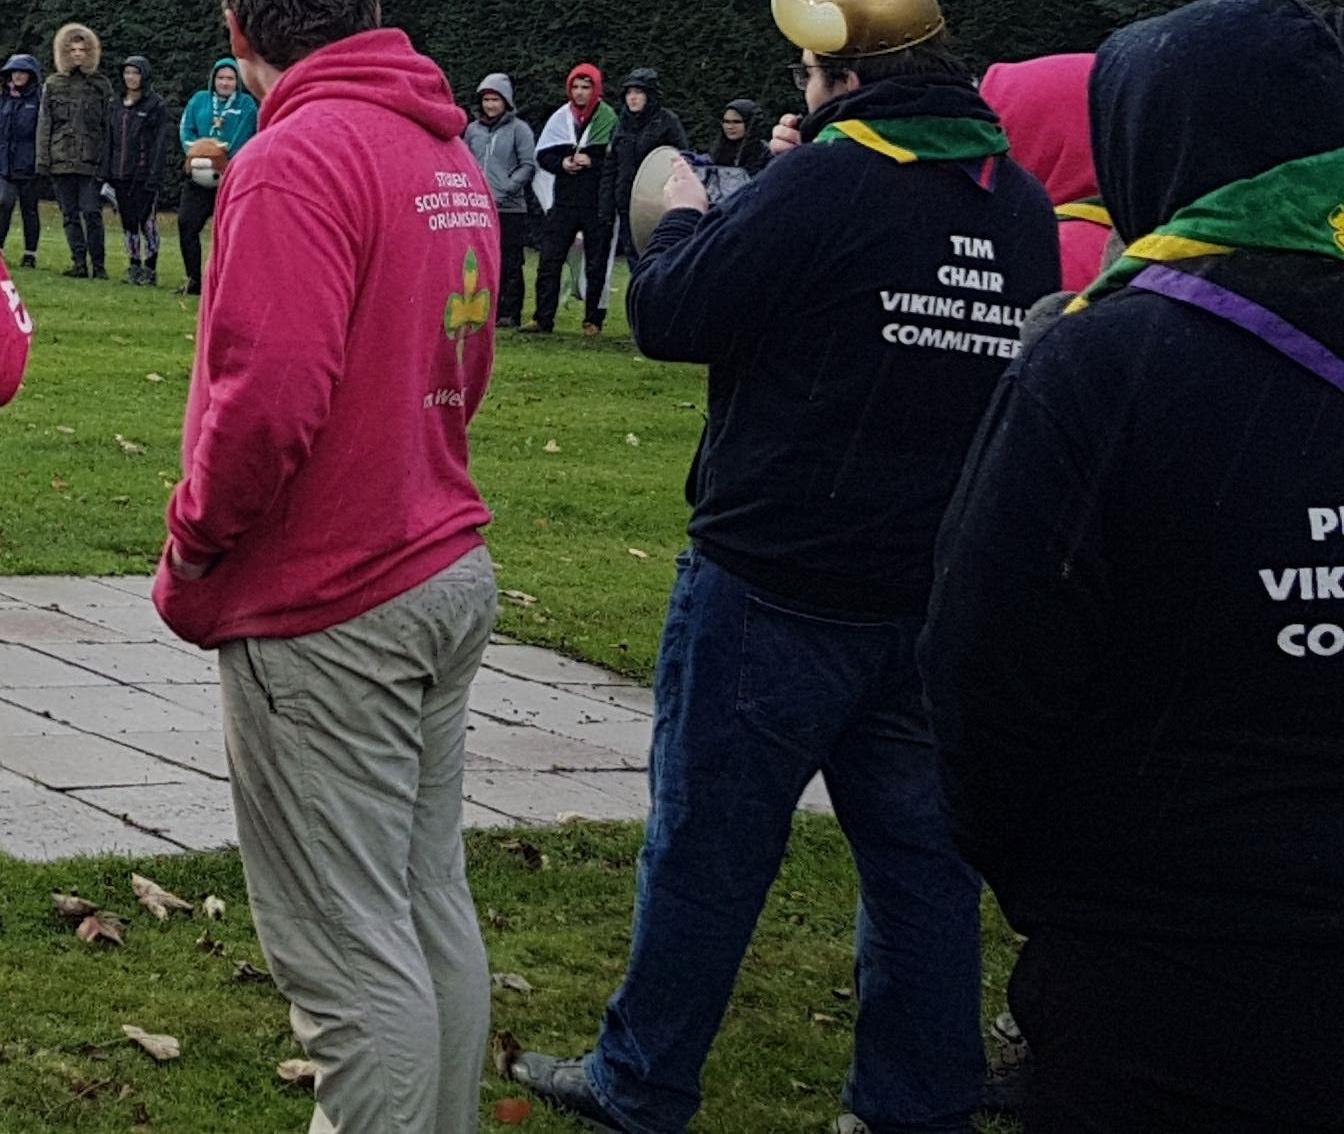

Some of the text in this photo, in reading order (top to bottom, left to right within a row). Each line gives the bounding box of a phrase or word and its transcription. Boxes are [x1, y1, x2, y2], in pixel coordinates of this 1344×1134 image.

[950, 235, 995, 261] TIM
[937, 265, 1004, 294] CHAIR
[879, 290, 1029, 328] VIKING RALL
